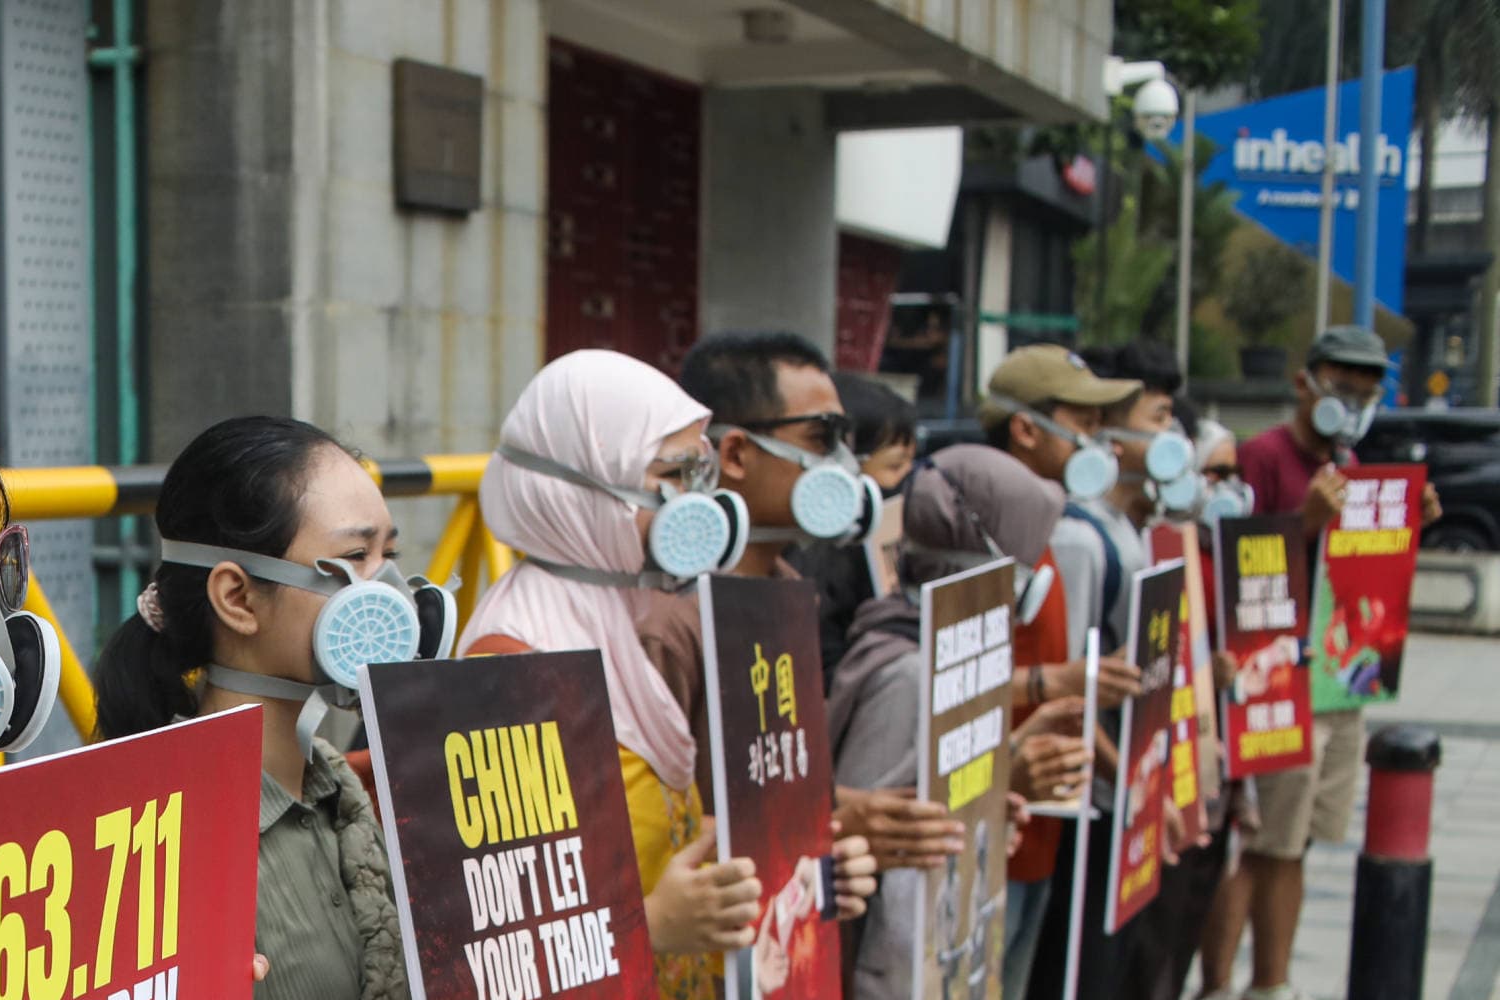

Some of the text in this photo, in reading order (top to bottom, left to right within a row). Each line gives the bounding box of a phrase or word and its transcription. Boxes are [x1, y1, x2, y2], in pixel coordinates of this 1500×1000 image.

[750, 642, 797, 733] 中国
[444, 720, 579, 849] CHINA
[462, 836, 588, 932] DON'T LET
[538, 907, 620, 994] TRADE
